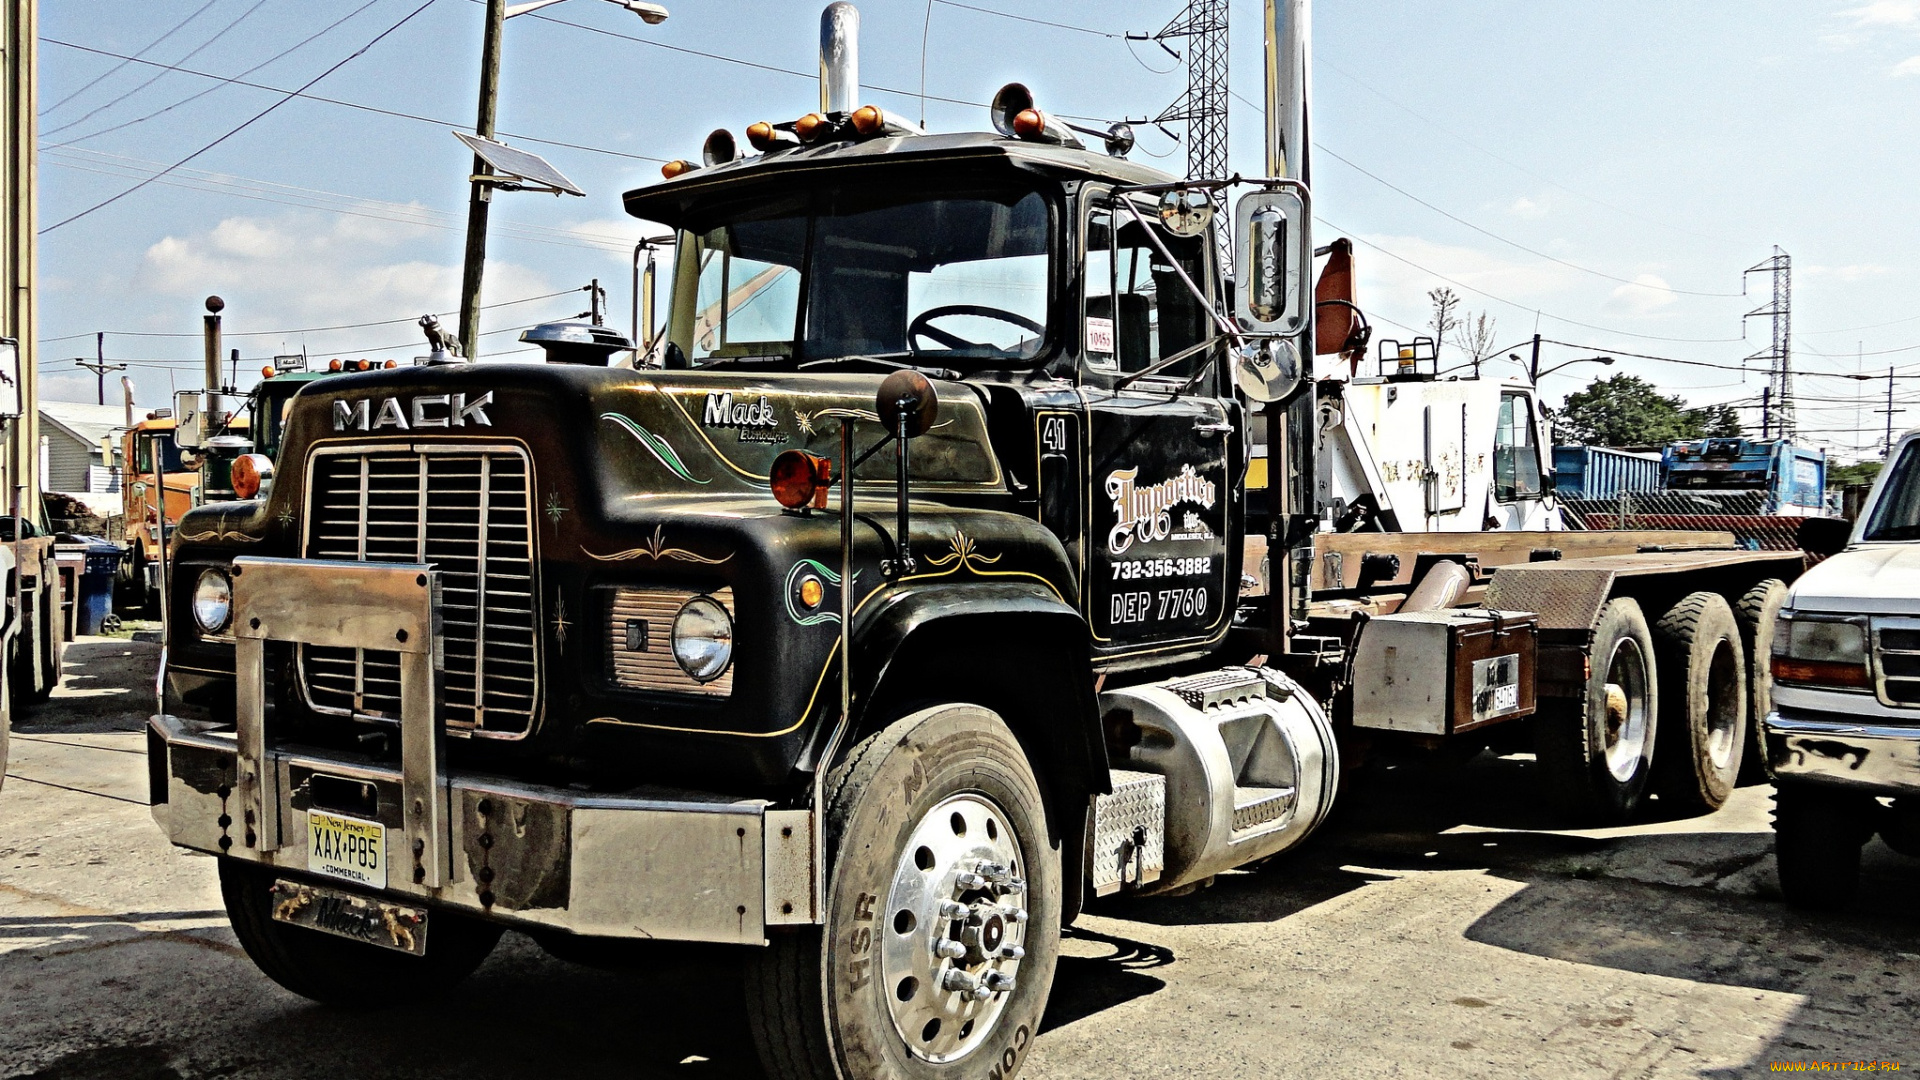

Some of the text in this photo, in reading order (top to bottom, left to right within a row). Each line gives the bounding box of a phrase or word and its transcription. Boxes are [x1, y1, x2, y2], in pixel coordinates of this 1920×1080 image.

[333, 390, 494, 431] MACK
[703, 392, 778, 427] Mack
[1043, 418, 1066, 450] 41
[1111, 557, 1211, 580] 732-356-3882
[1110, 587, 1207, 624] DEP 7760
[326, 815, 366, 834] New Jersey
[325, 864, 366, 882] COMMERCIAL
[850, 891, 877, 993] HSR
